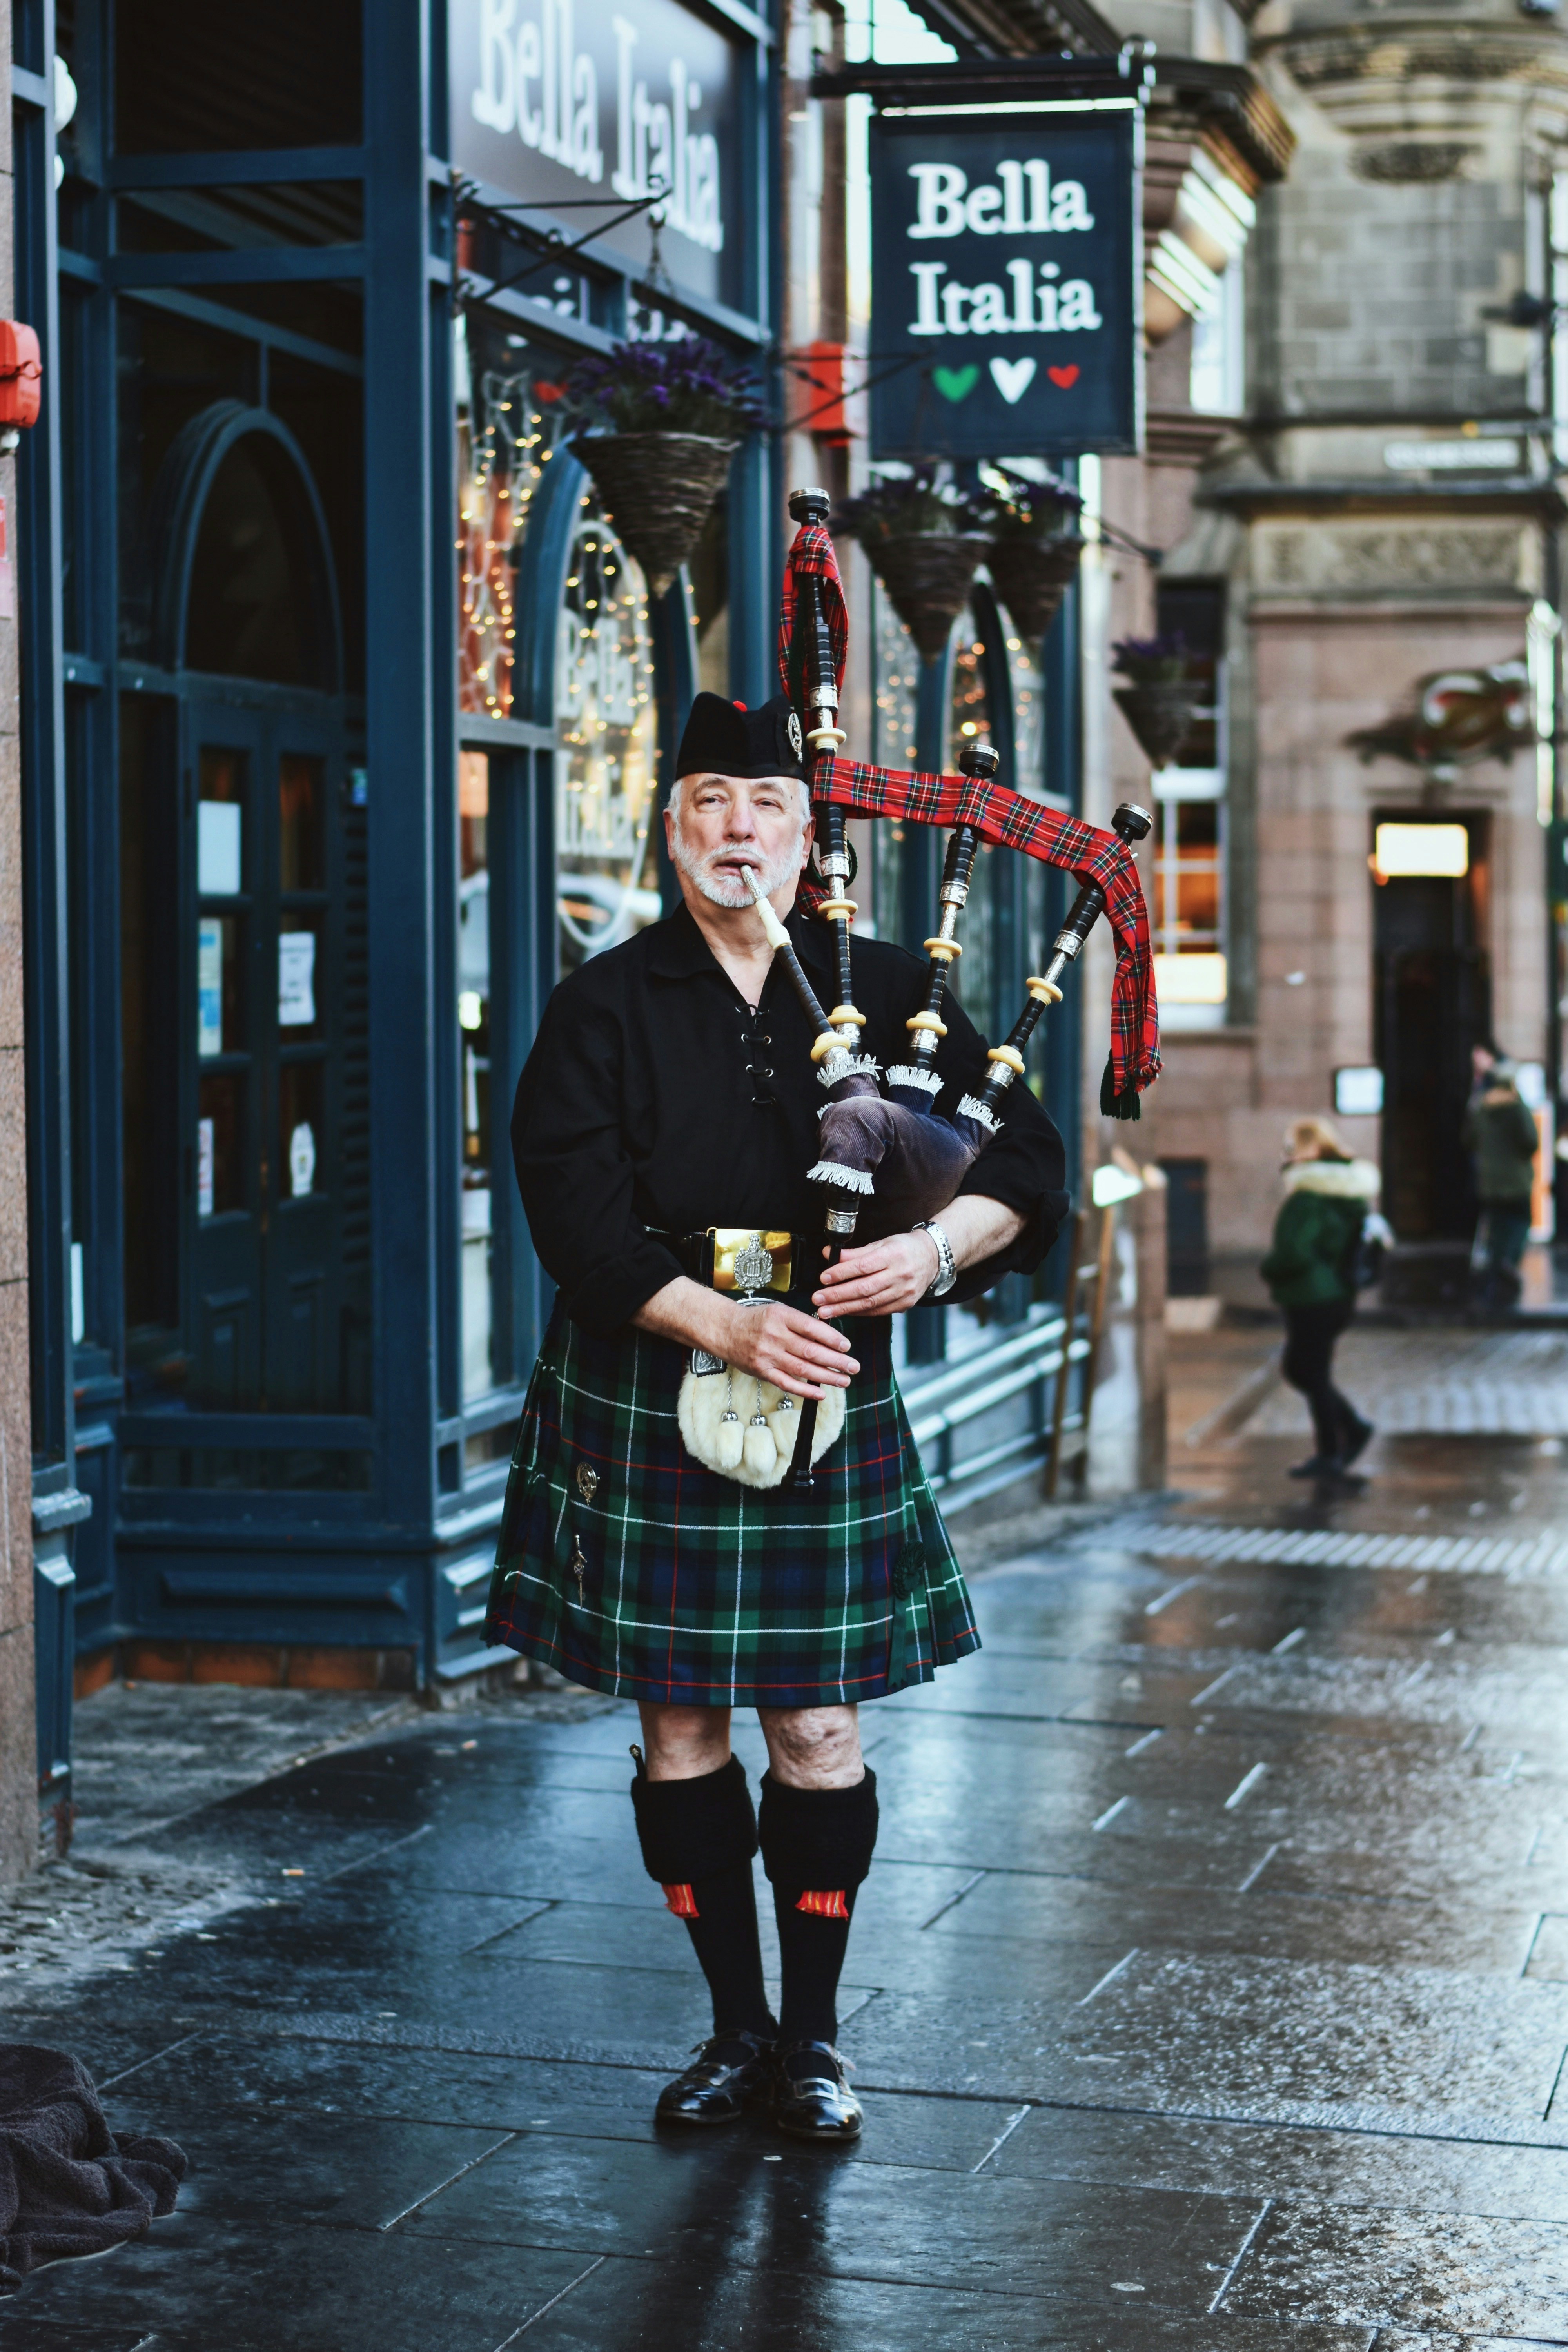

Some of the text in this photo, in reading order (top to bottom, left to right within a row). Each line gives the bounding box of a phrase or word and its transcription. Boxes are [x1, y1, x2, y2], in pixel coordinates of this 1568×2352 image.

[473, 0, 724, 252] Bella Italia
[907, 158, 1094, 239] Bella
[907, 258, 1102, 335] Italia
